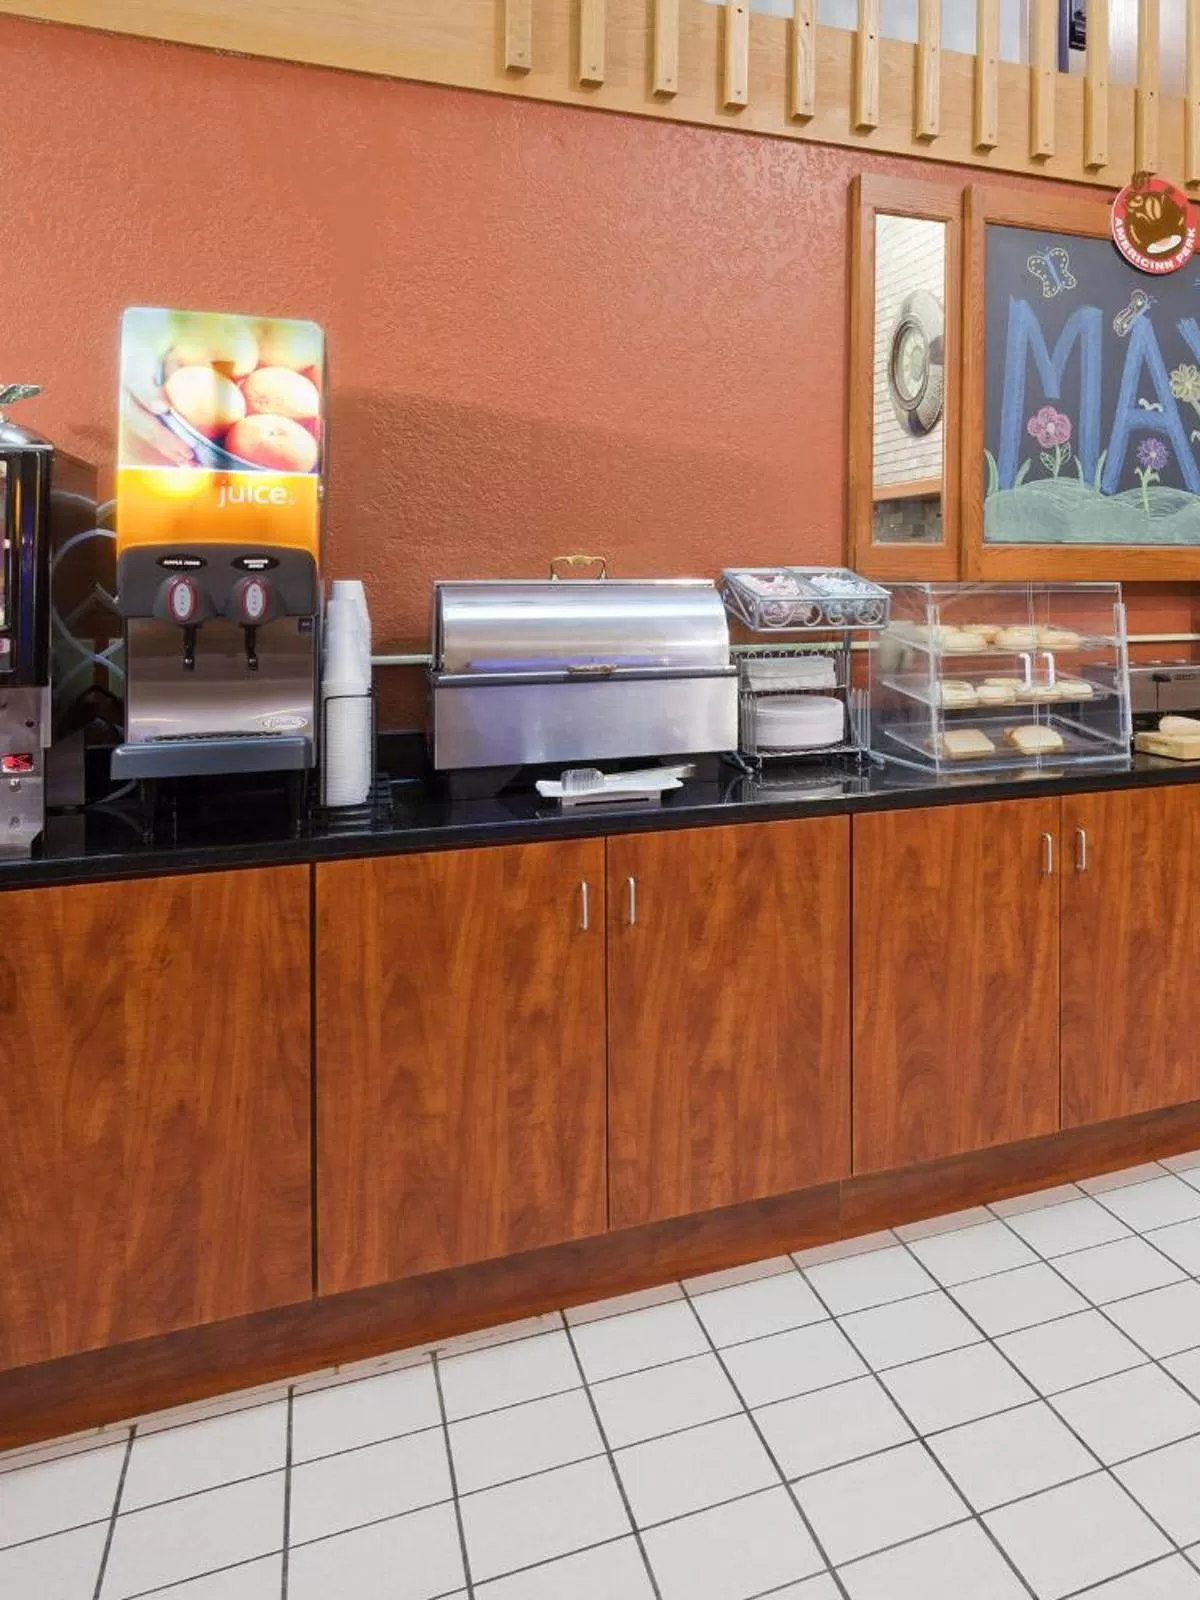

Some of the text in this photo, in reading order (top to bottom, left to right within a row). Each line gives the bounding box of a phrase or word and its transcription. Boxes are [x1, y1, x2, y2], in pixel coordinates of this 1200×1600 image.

[1114, 216, 1196, 269] AMERICINN PERK
[216, 478, 289, 509] juice
